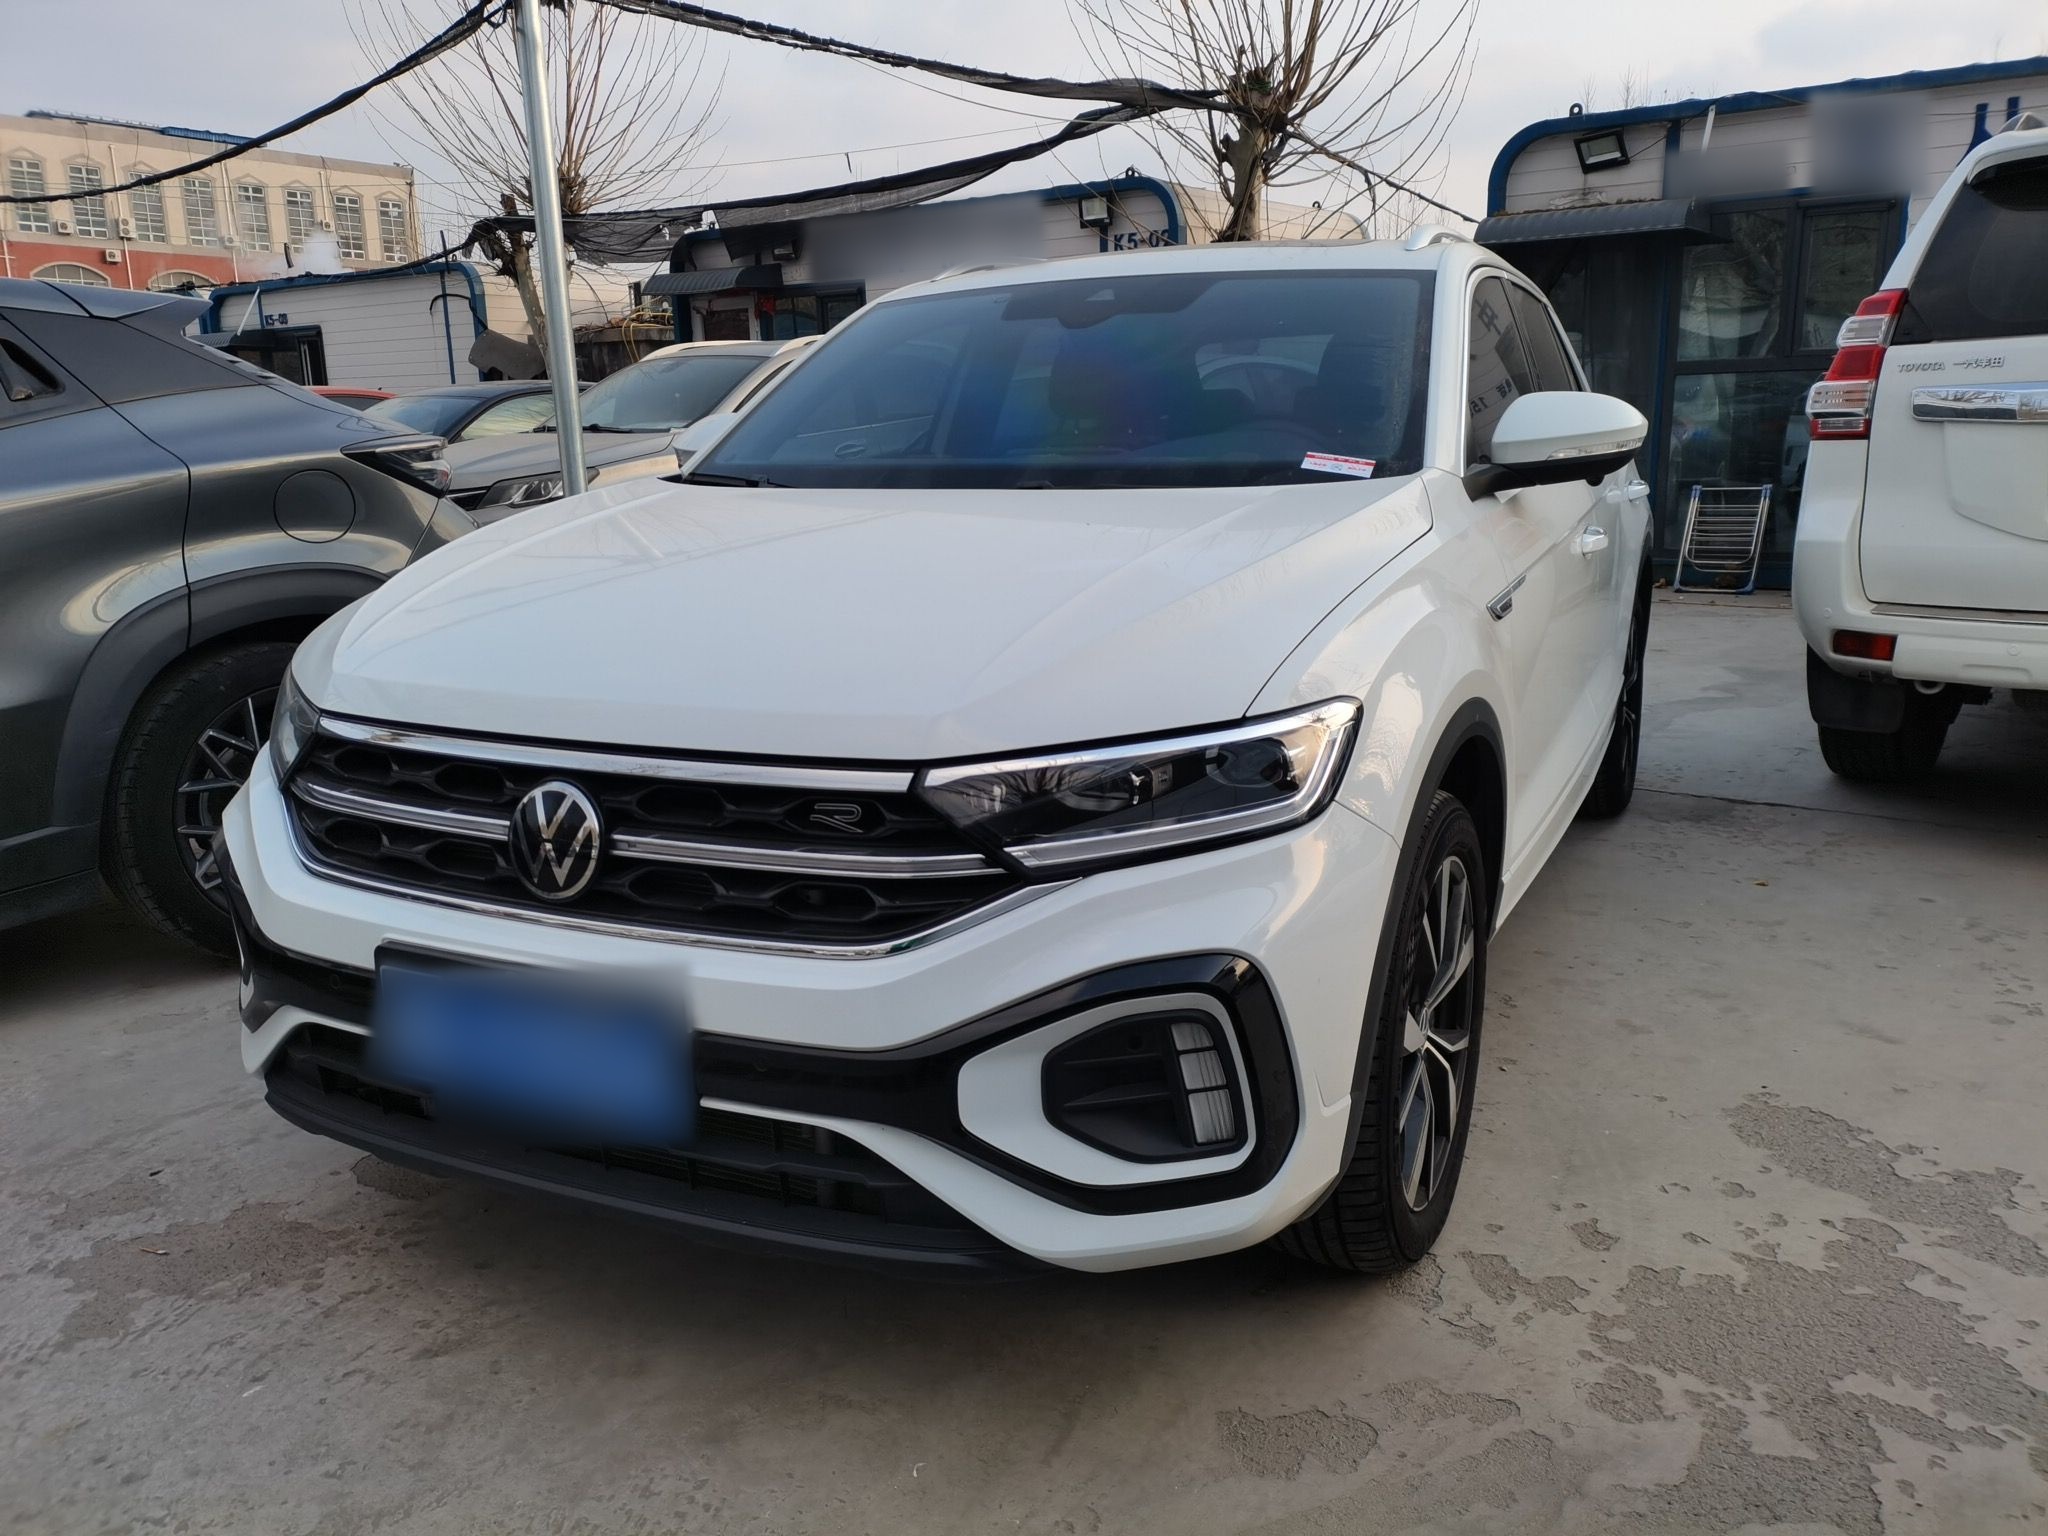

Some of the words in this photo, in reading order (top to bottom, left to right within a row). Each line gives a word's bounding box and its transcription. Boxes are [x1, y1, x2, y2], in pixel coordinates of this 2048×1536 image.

[1898, 361, 1946, 373] TOYOTA
[1953, 356, 2006, 369] 一汽丰田
[809, 803, 864, 833] R
